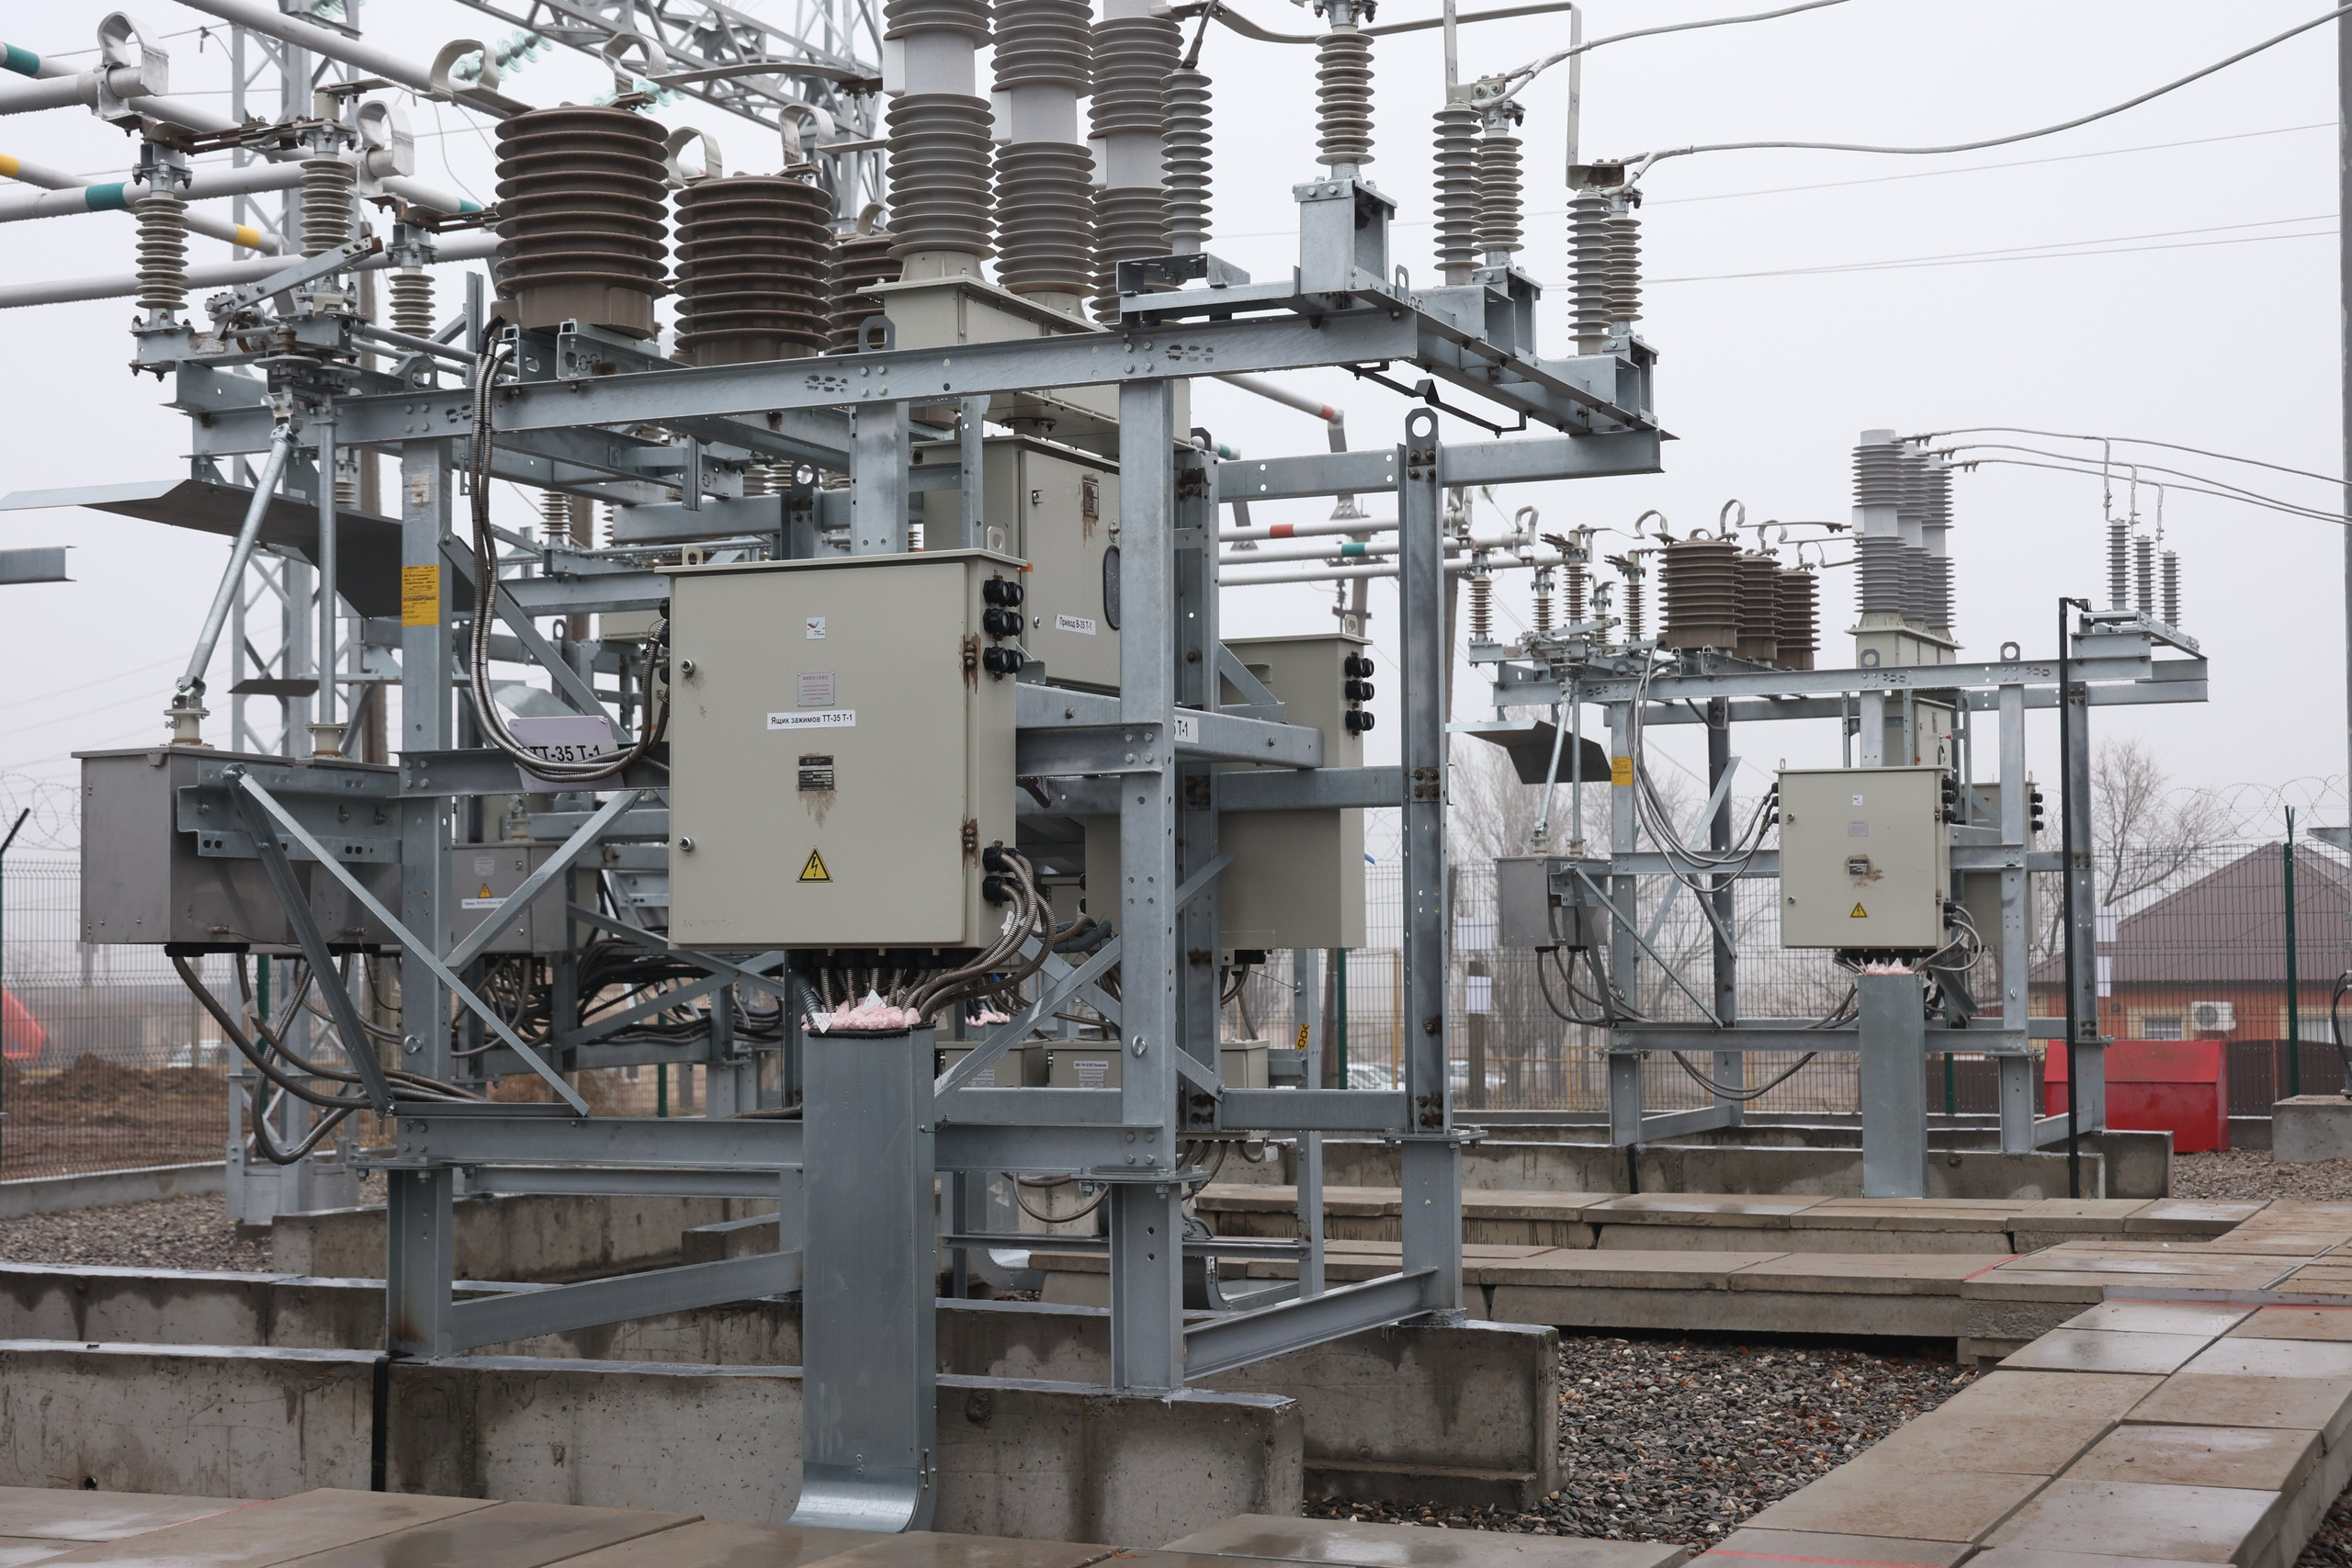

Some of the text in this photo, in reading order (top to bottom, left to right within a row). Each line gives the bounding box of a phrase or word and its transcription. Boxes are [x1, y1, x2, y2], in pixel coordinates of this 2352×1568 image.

[1059, 616, 1075, 628] Привод
[771, 716, 790, 726] Ящик
[791, 716, 821, 724] зажимов
[822, 714, 841, 722] ТТ-35
[1178, 720, 1188, 737] Т-1
[576, 745, 601, 760] Т-1
